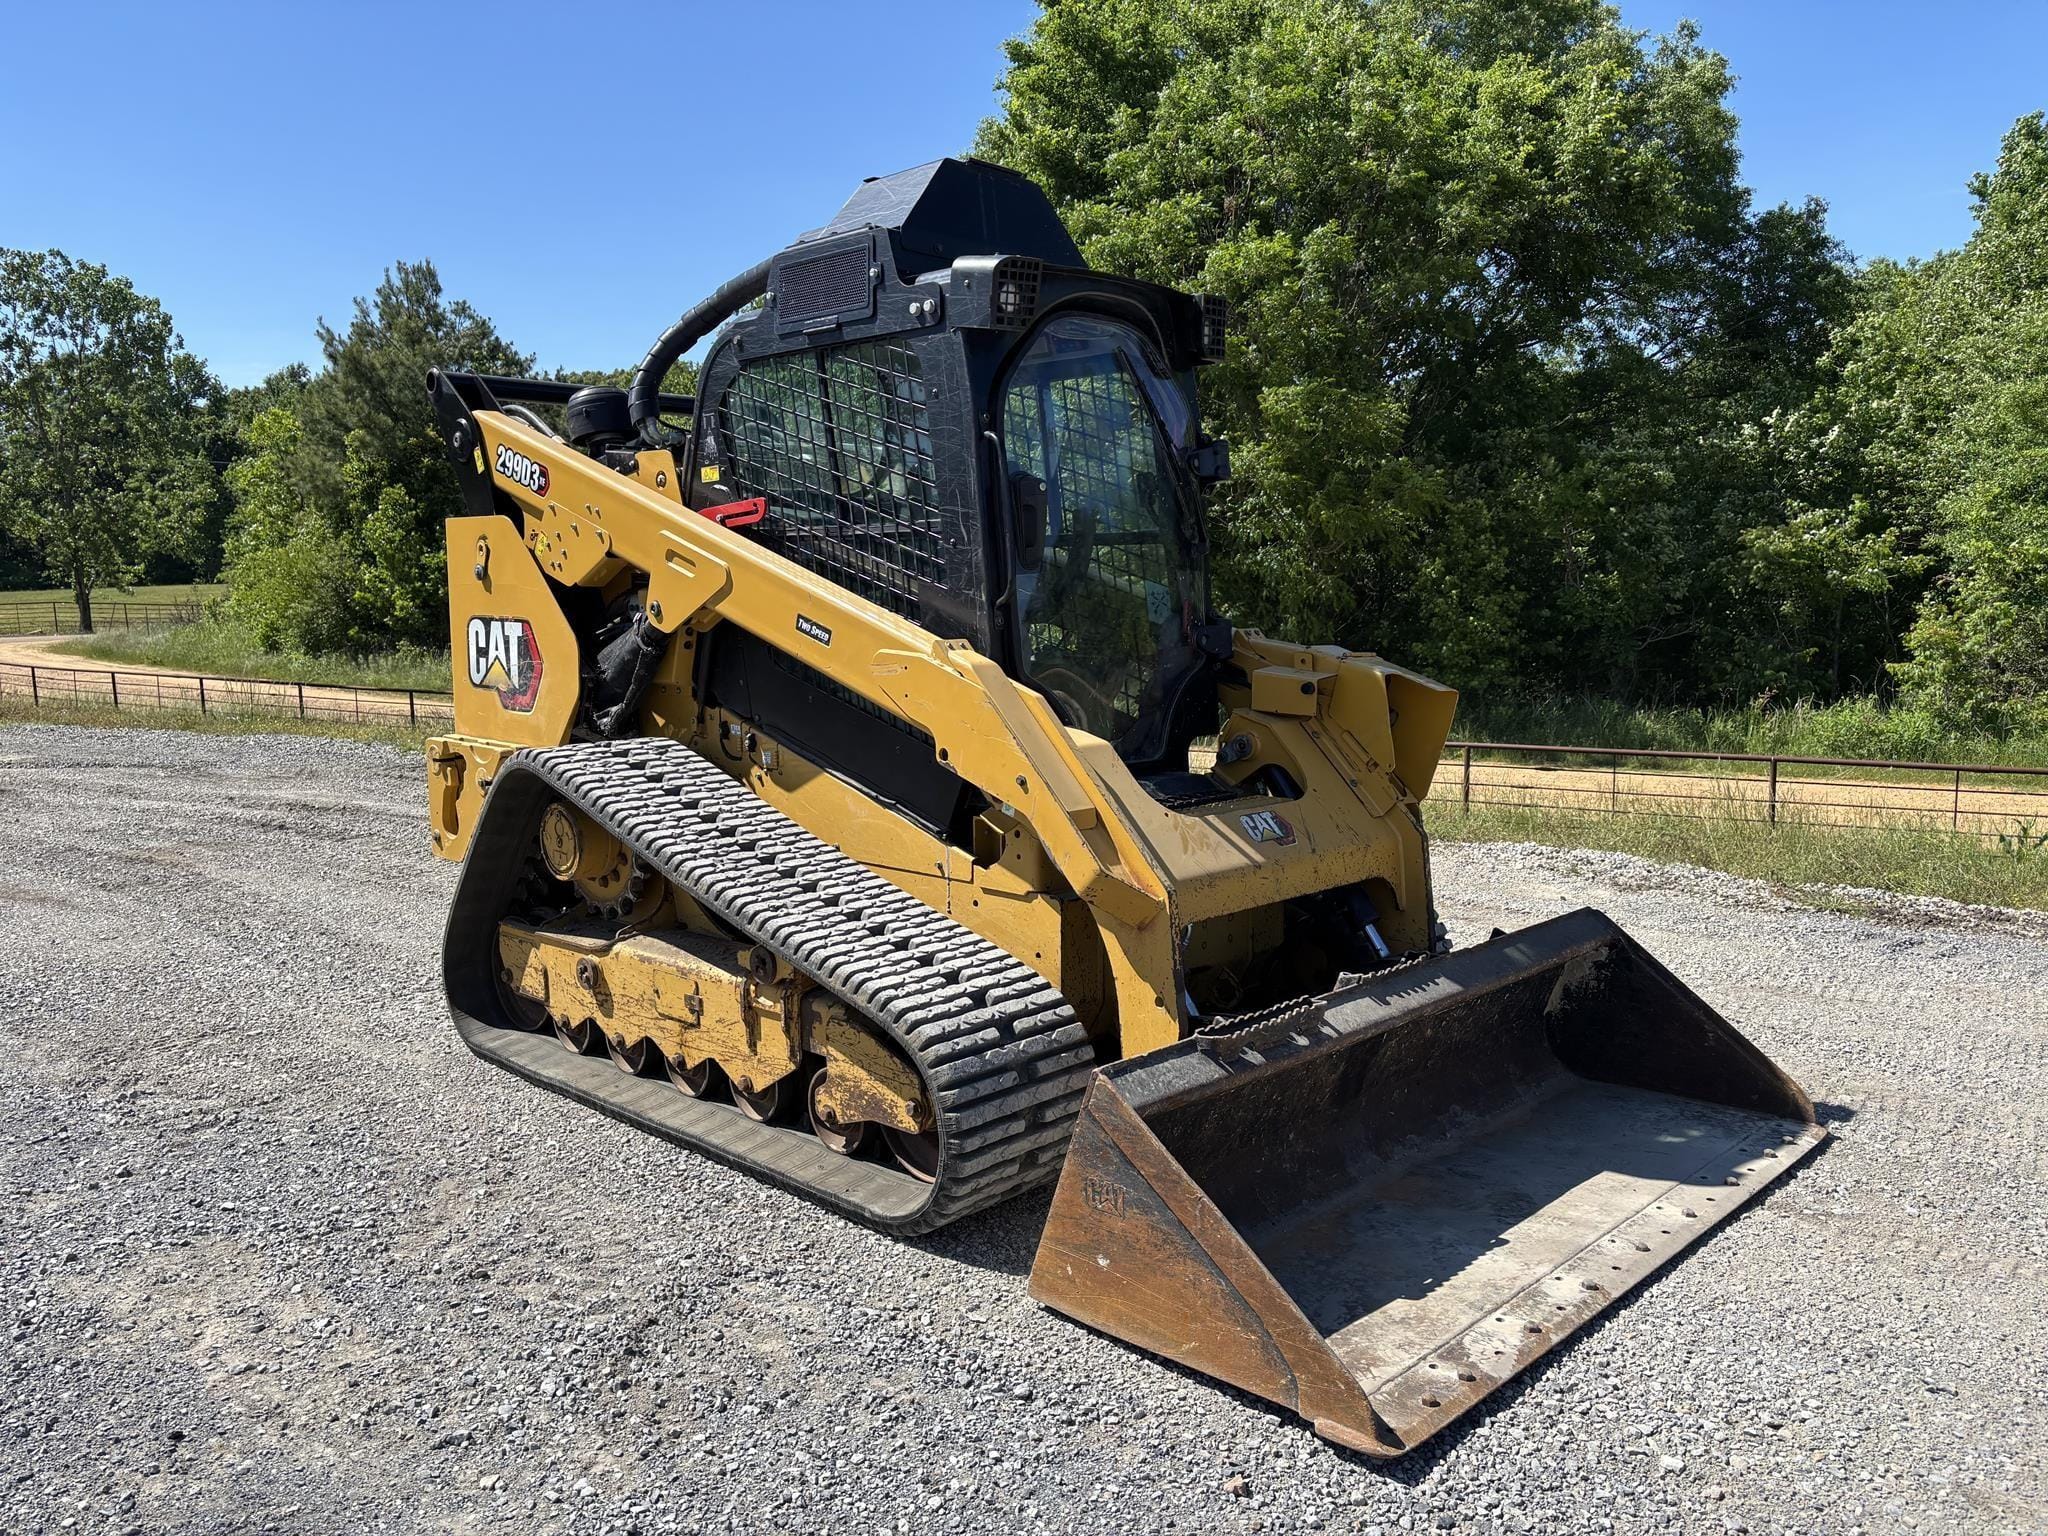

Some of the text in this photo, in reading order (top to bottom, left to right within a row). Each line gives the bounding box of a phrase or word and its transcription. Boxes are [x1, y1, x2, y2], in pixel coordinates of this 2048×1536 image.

[496, 444, 540, 491] 299D3
[798, 618, 829, 642] TWO SPEED
[468, 618, 523, 689] CAT
[1240, 811, 1285, 842] CAT
